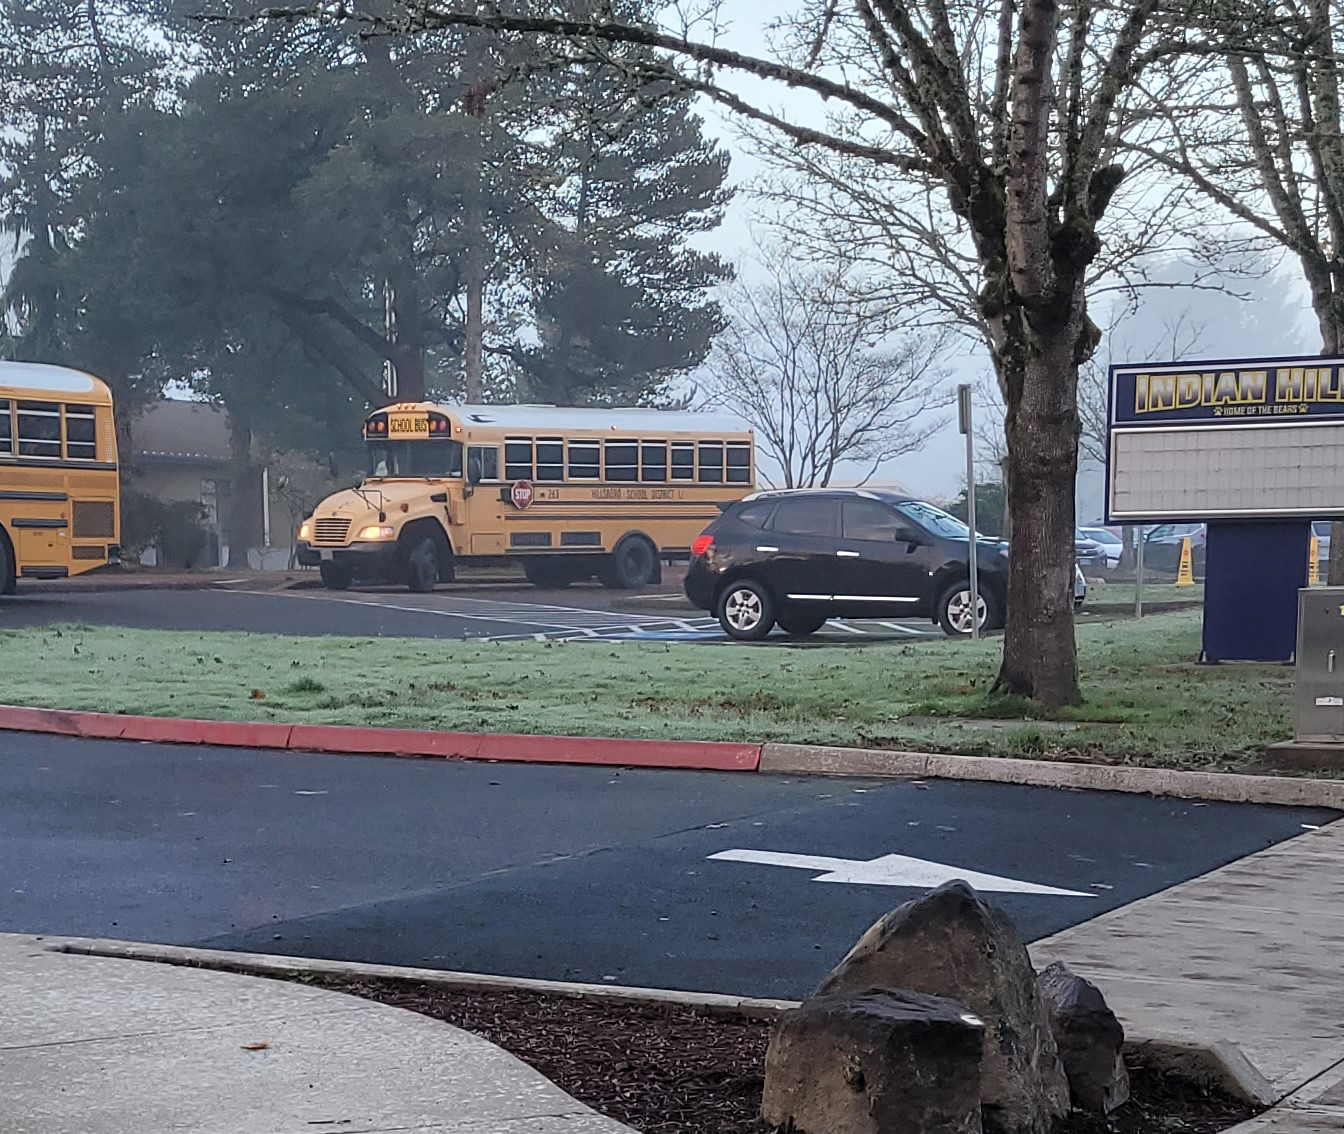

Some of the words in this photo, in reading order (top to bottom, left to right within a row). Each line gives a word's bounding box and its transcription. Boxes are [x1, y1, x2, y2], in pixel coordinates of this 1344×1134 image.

[1135, 370, 1267, 413] INDIAN
[1223, 406, 1245, 416] HOME
[1246, 406, 1257, 415] OF
[1258, 405, 1272, 414] THE
[1273, 404, 1298, 414] BEARS
[390, 418, 414, 433] SCHOOL
[414, 418, 427, 433] BUS
[514, 488, 531, 500] STOP
[591, 488, 622, 500] HILLSBORO
[626, 489, 648, 500] SCHOOL
[651, 489, 674, 500] DISTRICT
